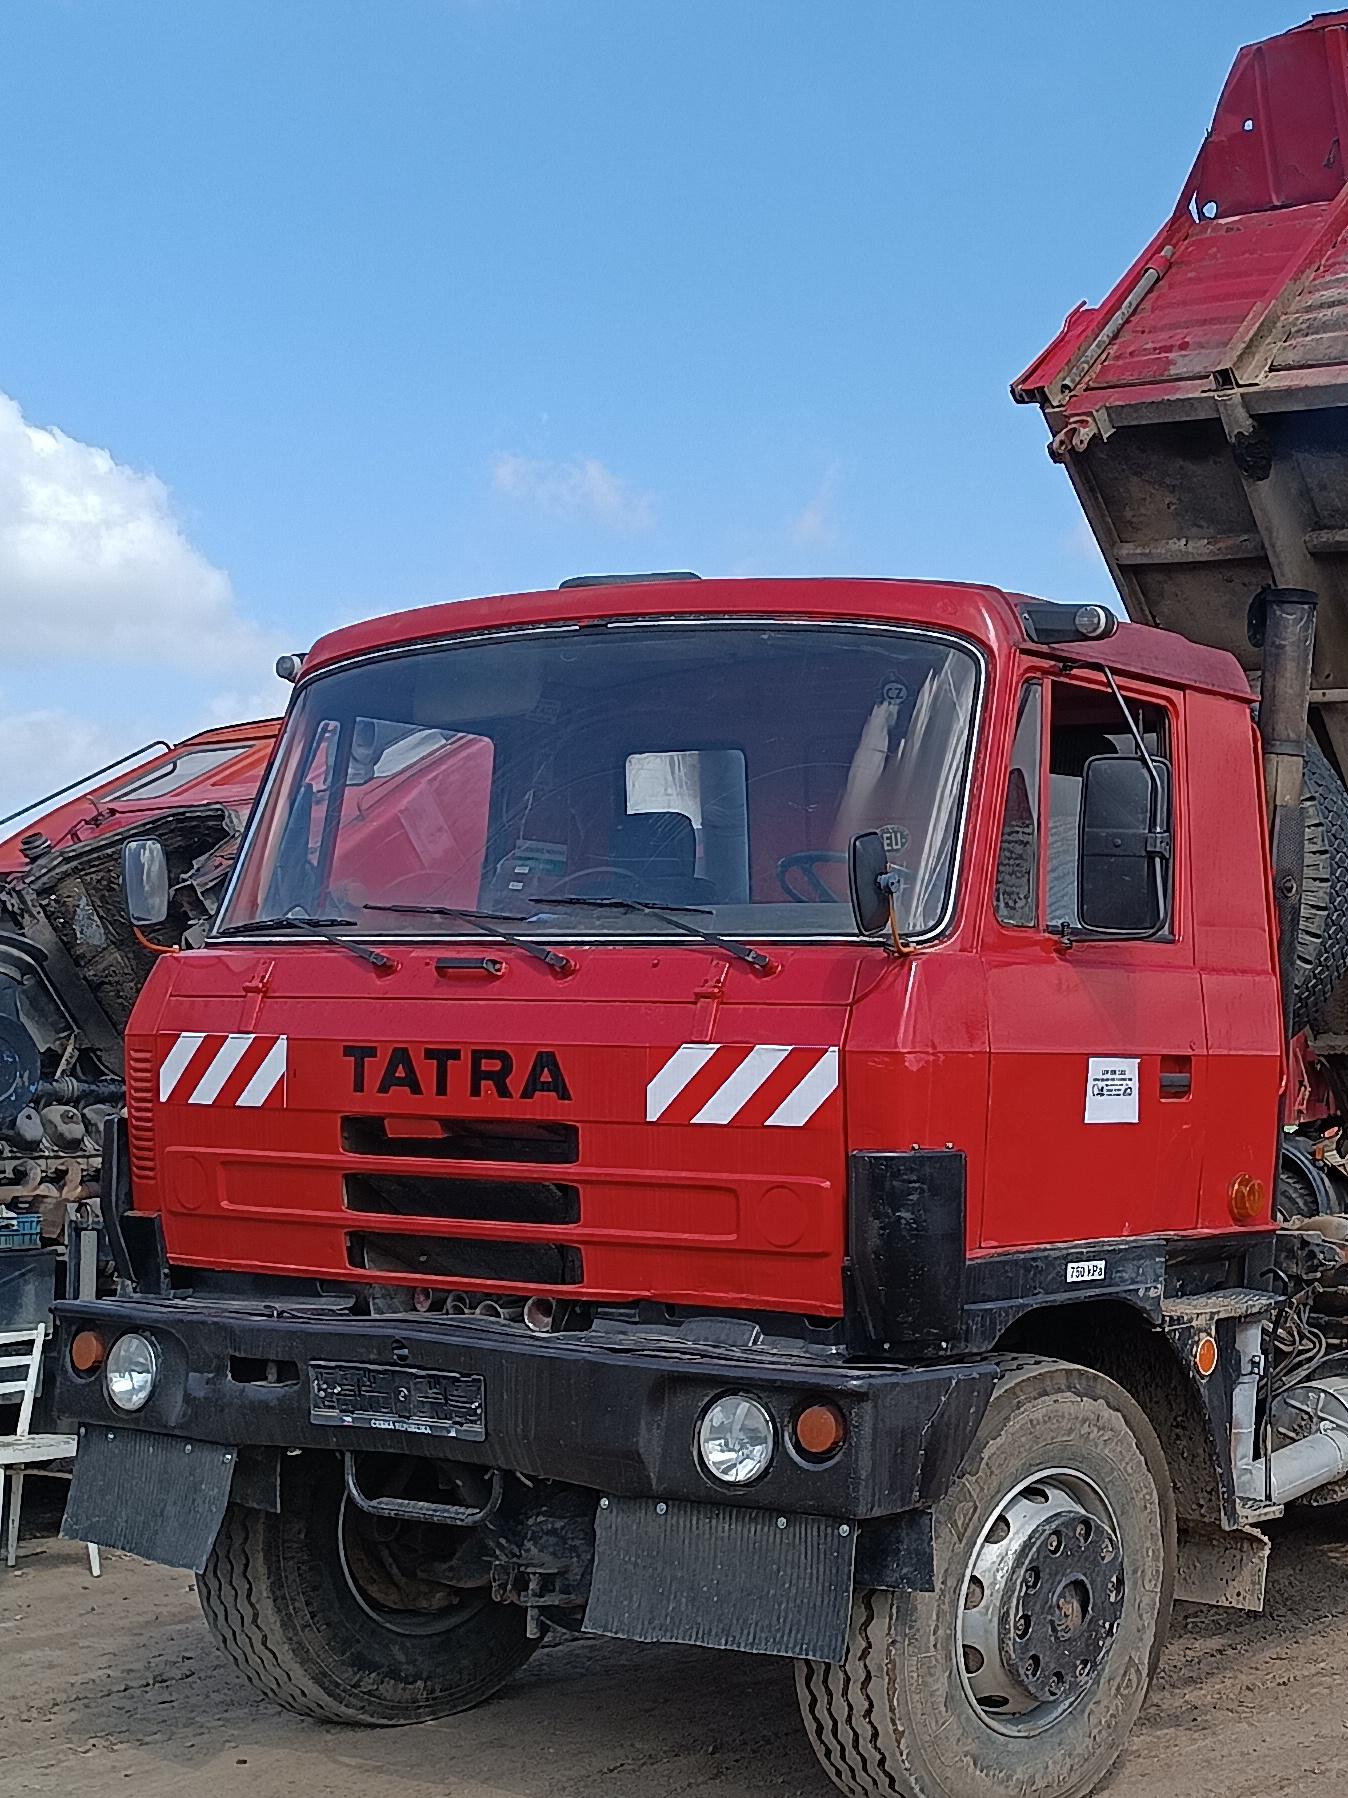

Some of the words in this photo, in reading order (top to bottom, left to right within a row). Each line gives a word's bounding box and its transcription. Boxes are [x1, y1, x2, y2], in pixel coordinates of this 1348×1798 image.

[886, 687, 904, 700] CZ
[883, 832, 902, 850] EU
[343, 1045, 573, 1101] TATRA
[1070, 1266, 1085, 1279] 750
[1087, 1264, 1103, 1277] kPa
